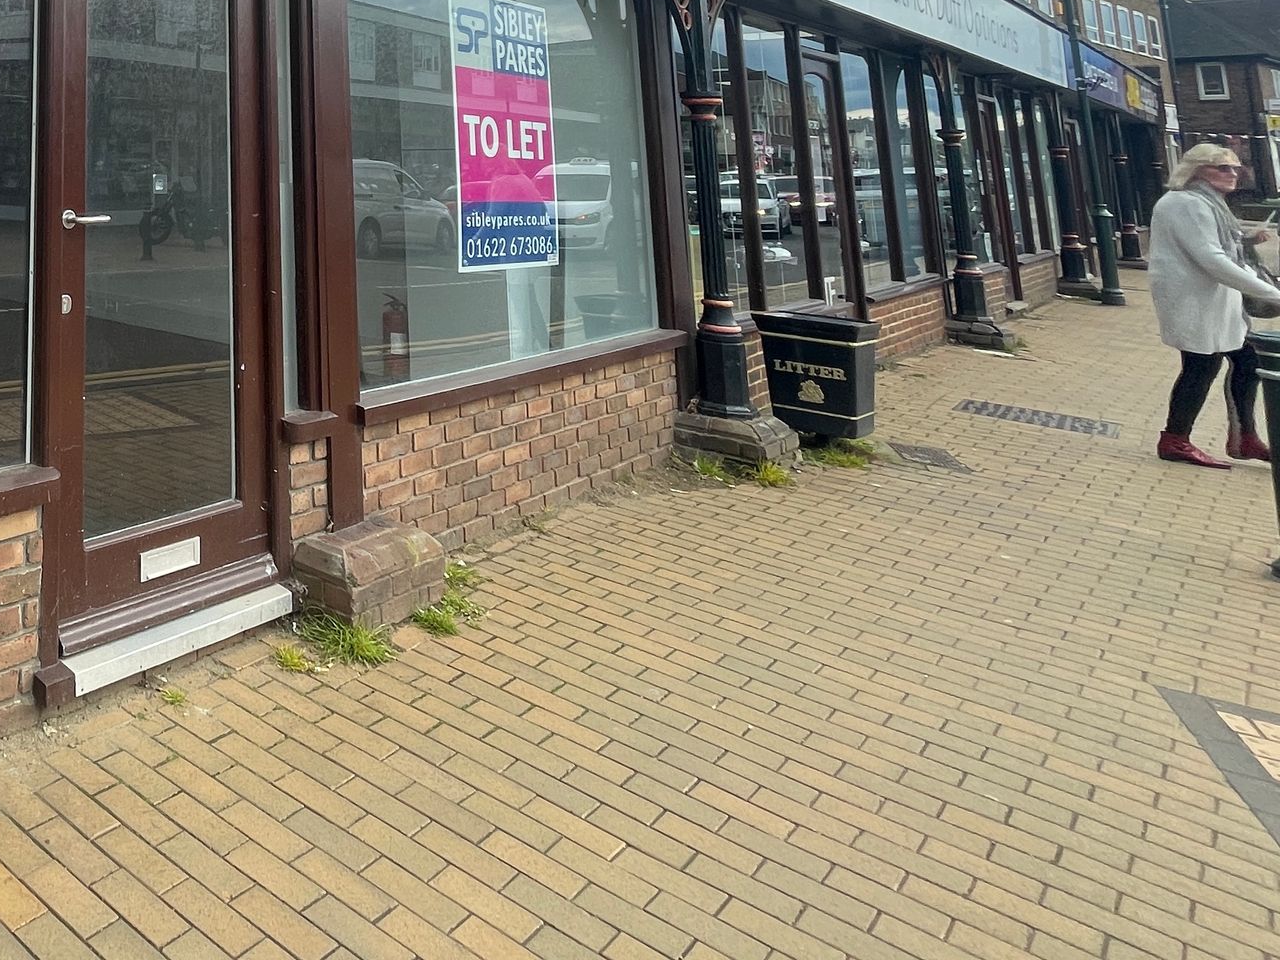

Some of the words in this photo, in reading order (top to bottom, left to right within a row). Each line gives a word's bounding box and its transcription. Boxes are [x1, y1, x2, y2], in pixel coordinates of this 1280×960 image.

[493, 4, 543, 43] SIBLEY
[495, 39, 546, 77] PARES
[463, 114, 500, 158] TO
[506, 119, 547, 160] LET
[466, 211, 551, 231] sibleypares.co.uk
[467, 238, 507, 258] 01622
[510, 236, 553, 256] 673086
[773, 359, 847, 381] LITTER
